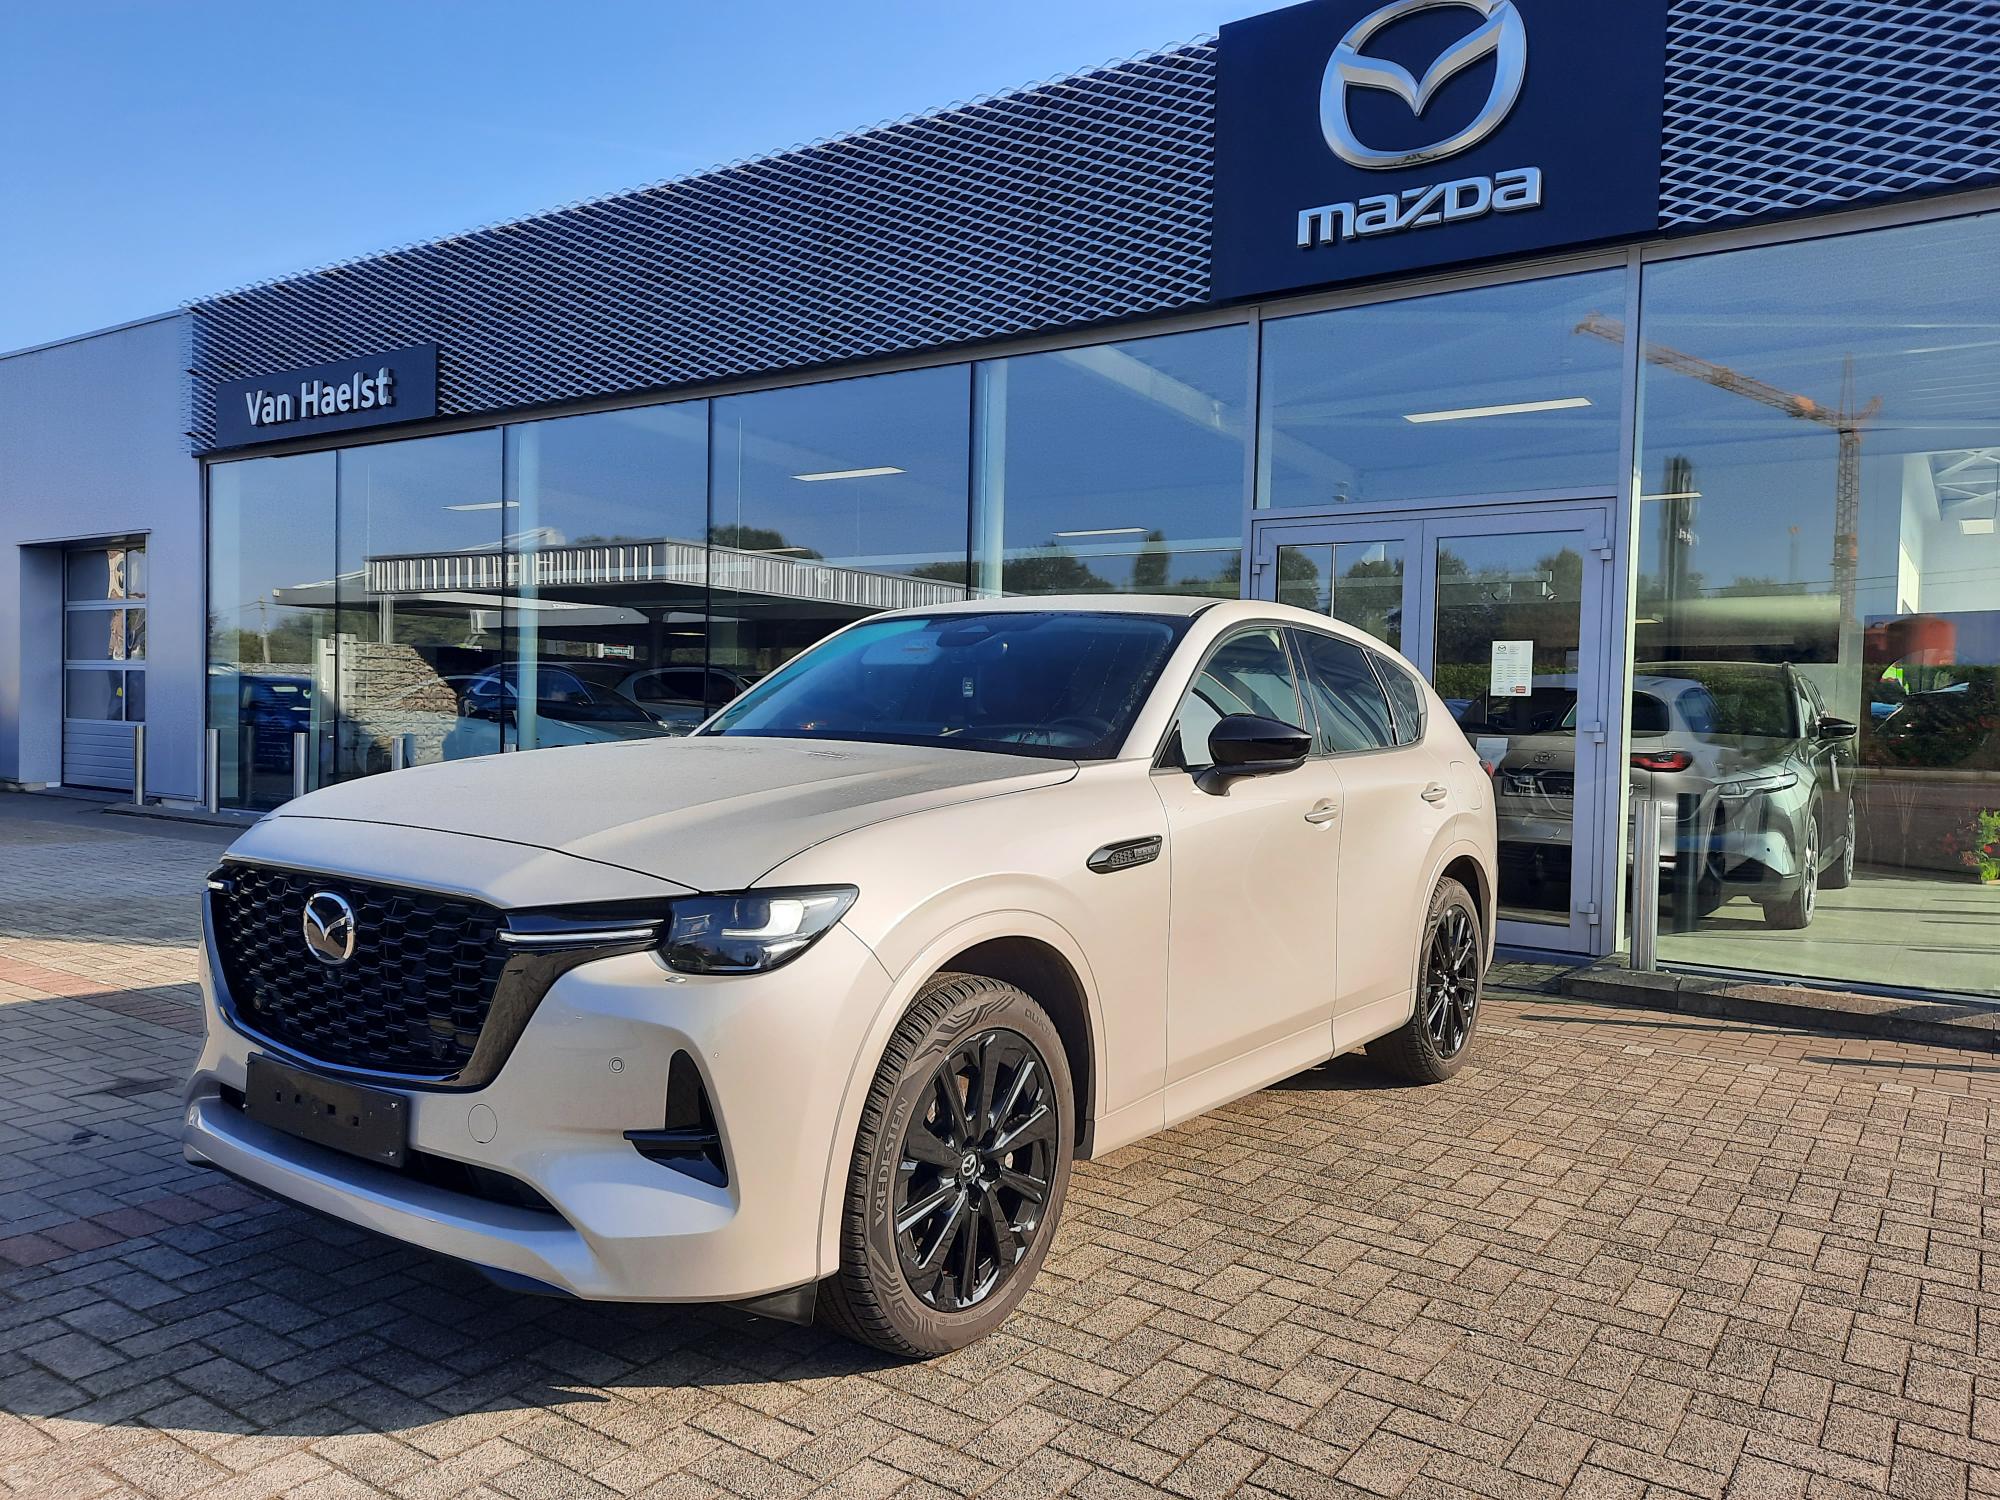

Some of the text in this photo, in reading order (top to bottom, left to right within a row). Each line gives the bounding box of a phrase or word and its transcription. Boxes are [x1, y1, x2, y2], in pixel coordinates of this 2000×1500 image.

[245, 367, 391, 425] Van Haelst
[875, 1097, 908, 1226] VREDESTEIN
